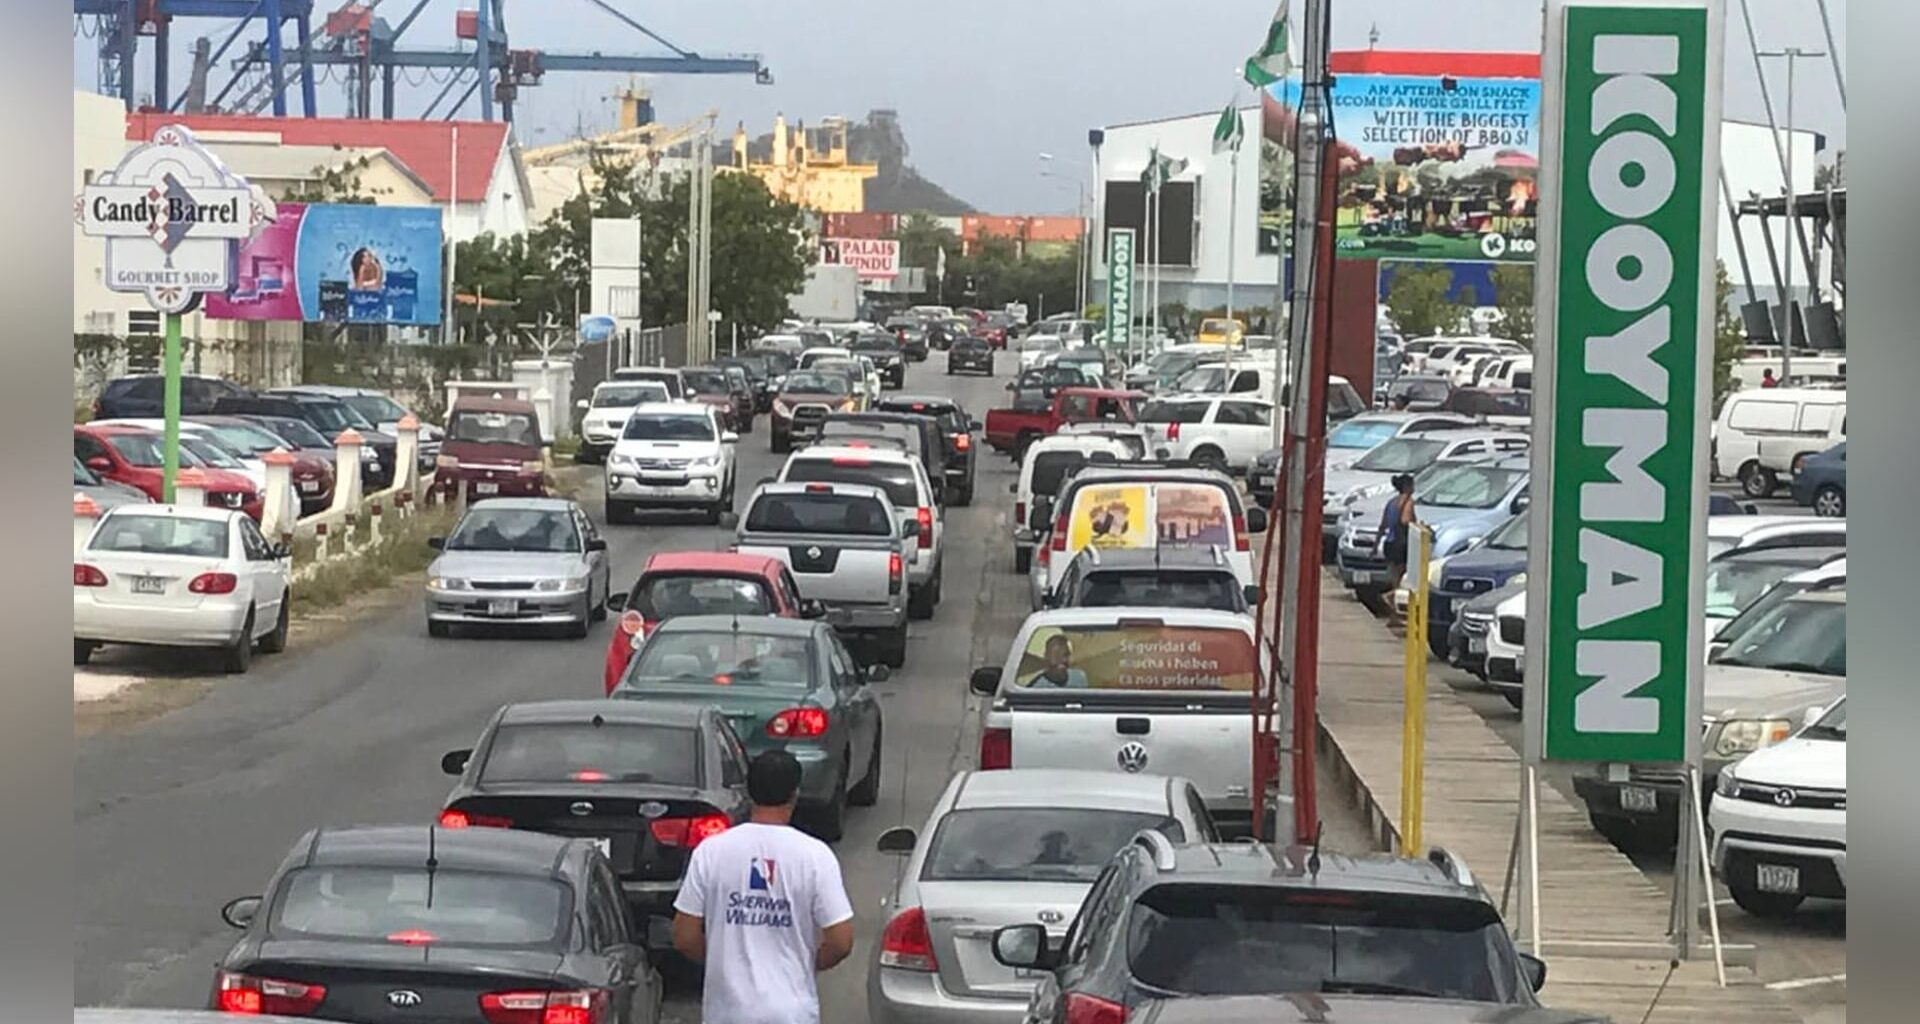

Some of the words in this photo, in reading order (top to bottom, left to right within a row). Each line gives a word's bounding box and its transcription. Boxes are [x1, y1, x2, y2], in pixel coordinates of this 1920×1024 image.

[1368, 84, 1390, 95] AN
[1481, 87, 1530, 98] SNACK
[1334, 95, 1393, 107] ECOMES
[1395, 97, 1406, 107] A
[1409, 97, 1447, 108] HUGE
[1373, 110, 1419, 126] WITH
[1424, 111, 1456, 127] THE
[1461, 112, 1529, 128] BIGGEST
[1362, 126, 1447, 143] SELECTION
[1452, 129, 1472, 144] OF
[93, 196, 160, 228] Candy
[168, 196, 238, 223] Barrel
[842, 240, 895, 256] PALAIS
[117, 270, 180, 283] GOURMET
[183, 271, 220, 284] SHOP
[1112, 234, 1130, 343] KOOYMAN
[1575, 34, 1679, 733] KOOYMAN
[726, 909, 792, 928] WILLIAMS
